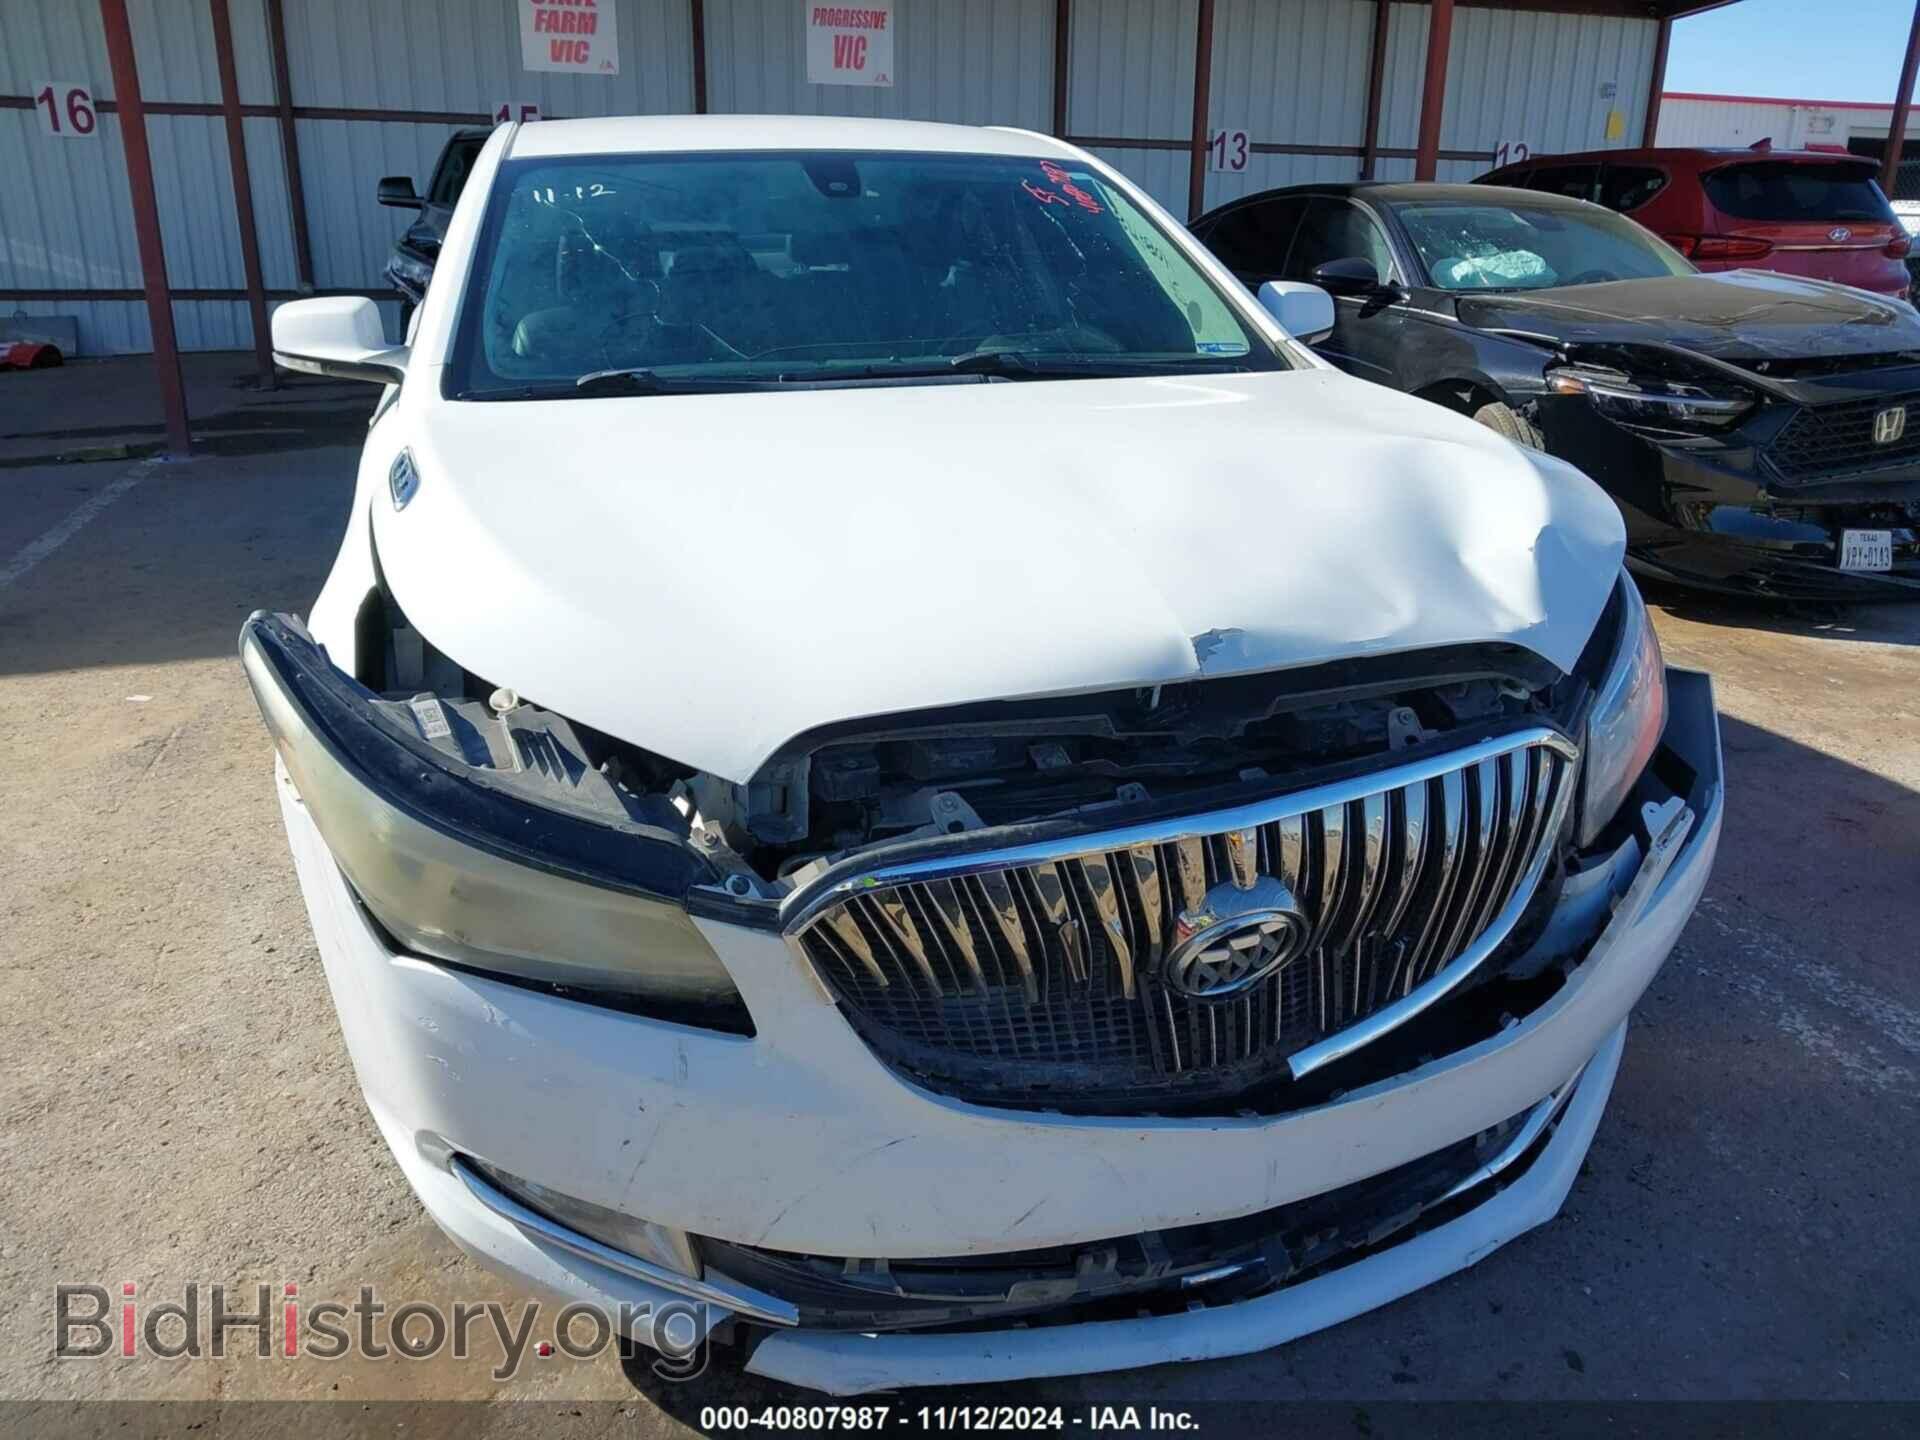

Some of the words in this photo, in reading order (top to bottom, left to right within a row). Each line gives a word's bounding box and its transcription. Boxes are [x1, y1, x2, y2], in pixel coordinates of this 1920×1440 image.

[534, 9, 598, 35] FARM
[812, 8, 887, 29] PROGRESSIVE
[550, 39, 590, 64] VIC
[834, 35, 866, 70] VIC
[38, 86, 95, 134] 16
[1215, 132, 1247, 170] 13
